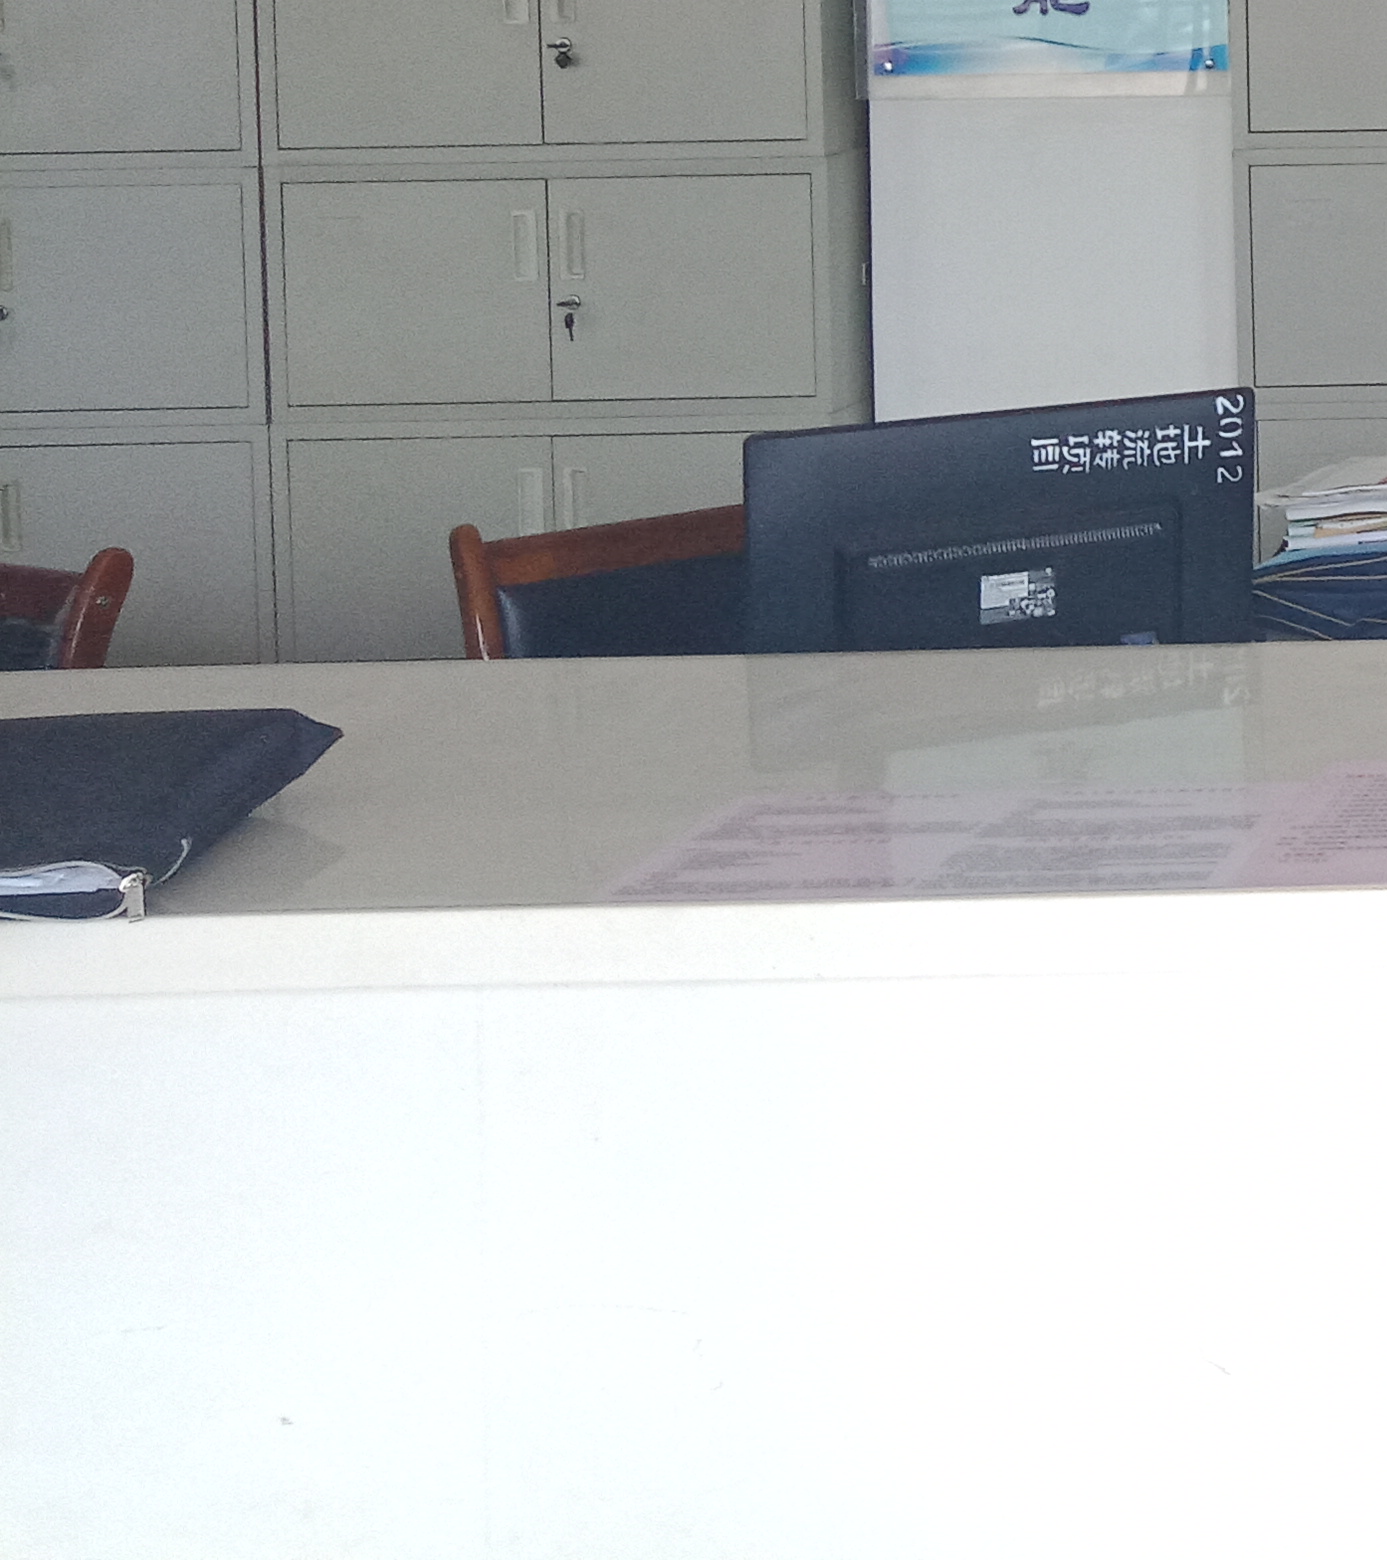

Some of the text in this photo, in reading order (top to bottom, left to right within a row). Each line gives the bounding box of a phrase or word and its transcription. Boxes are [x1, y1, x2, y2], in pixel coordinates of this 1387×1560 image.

[1031, 424, 1211, 474] 土地流转项目
[1214, 393, 1245, 484] 2012
